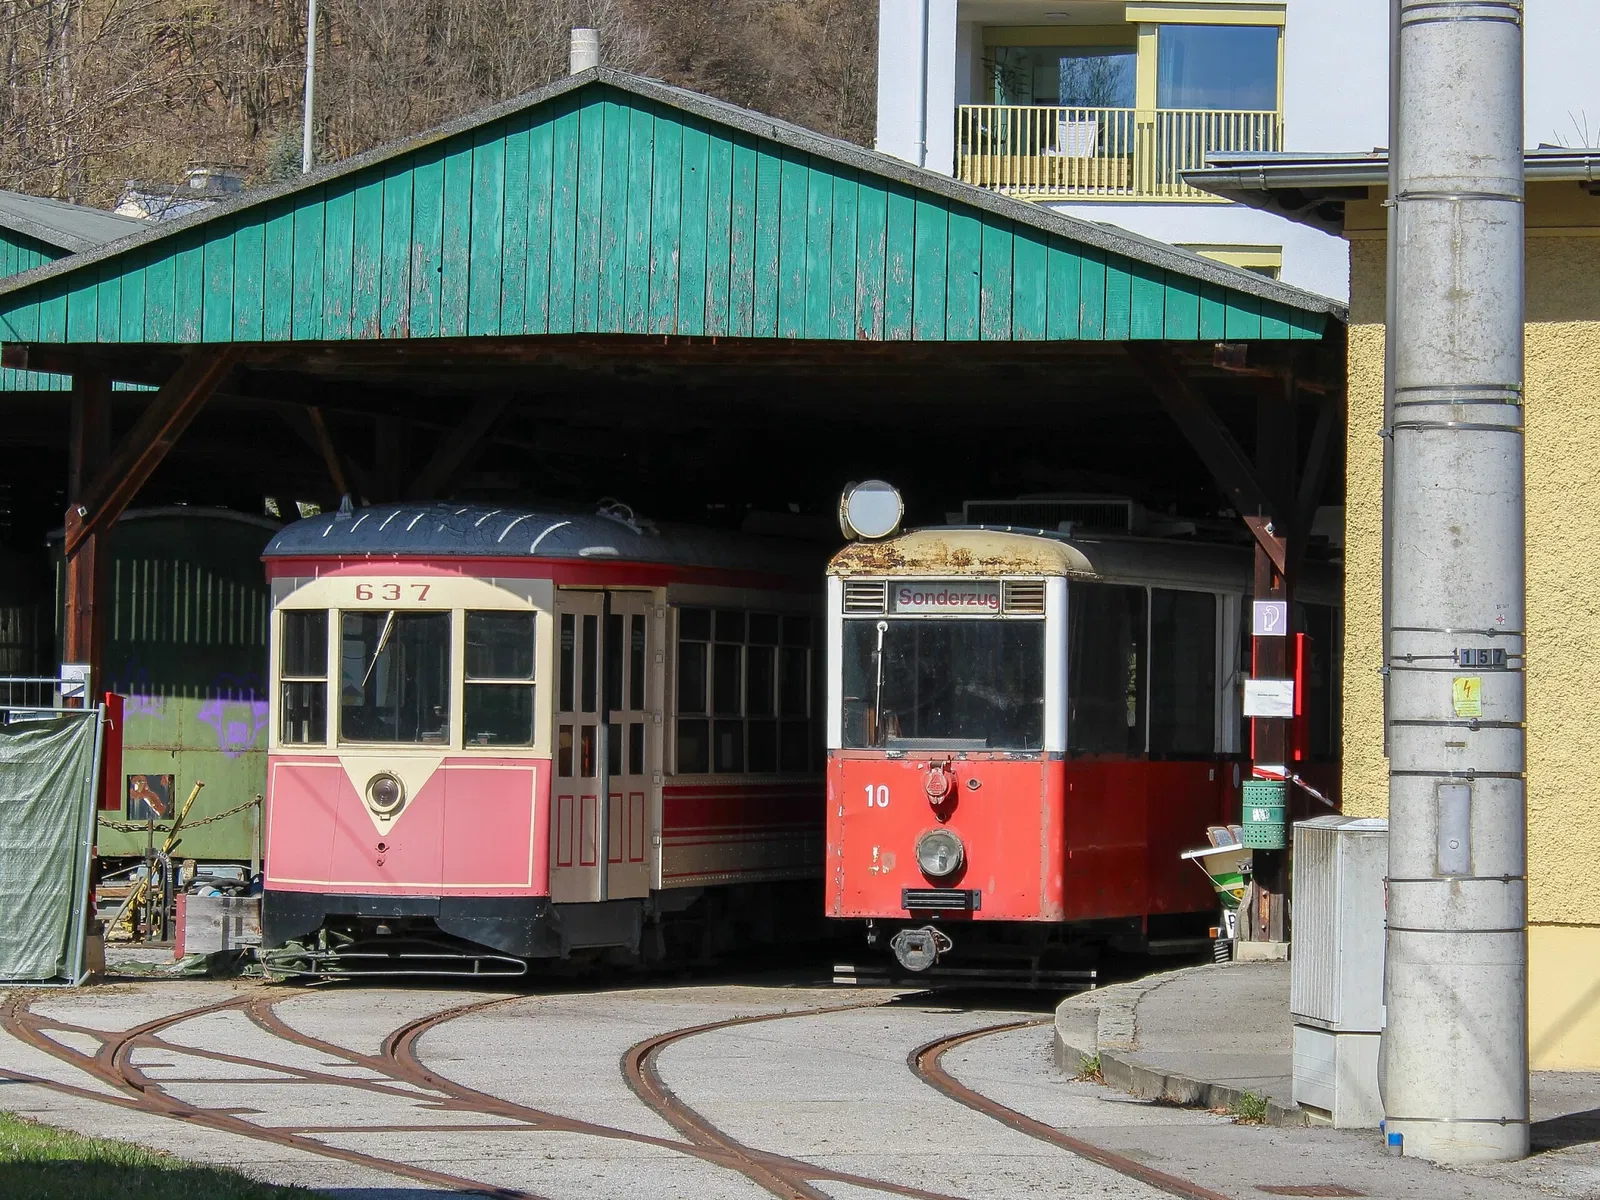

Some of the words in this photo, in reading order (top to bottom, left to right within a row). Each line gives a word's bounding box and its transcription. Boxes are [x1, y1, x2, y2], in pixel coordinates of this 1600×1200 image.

[355, 583, 431, 602] 637
[899, 588, 1000, 610] Sonderzug
[1462, 649, 1503, 664] 157
[864, 784, 890, 808] 10
